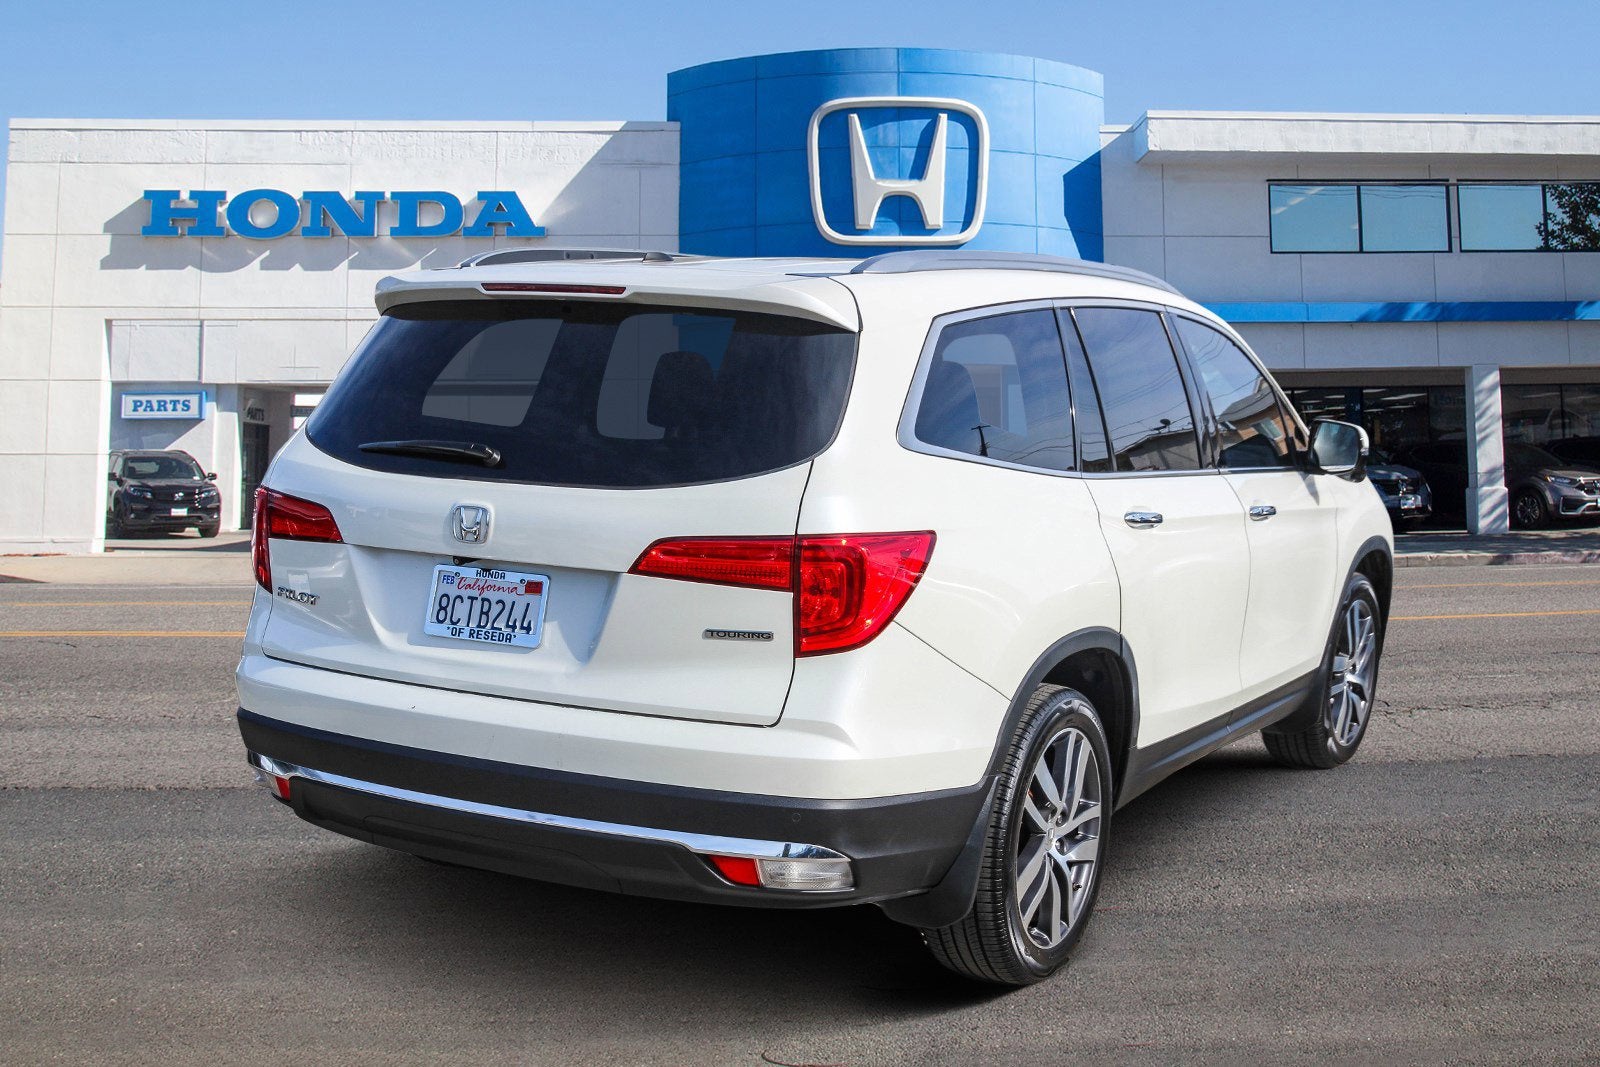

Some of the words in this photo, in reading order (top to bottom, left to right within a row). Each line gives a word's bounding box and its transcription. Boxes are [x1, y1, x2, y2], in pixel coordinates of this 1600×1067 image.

[141, 188, 547, 239] HONDA
[132, 399, 192, 412] PARTS
[442, 574, 456, 585] FEB
[475, 569, 506, 580] HONDA
[457, 577, 525, 597] California
[435, 593, 532, 634] 8CTB244
[706, 629, 773, 640] TOURING
